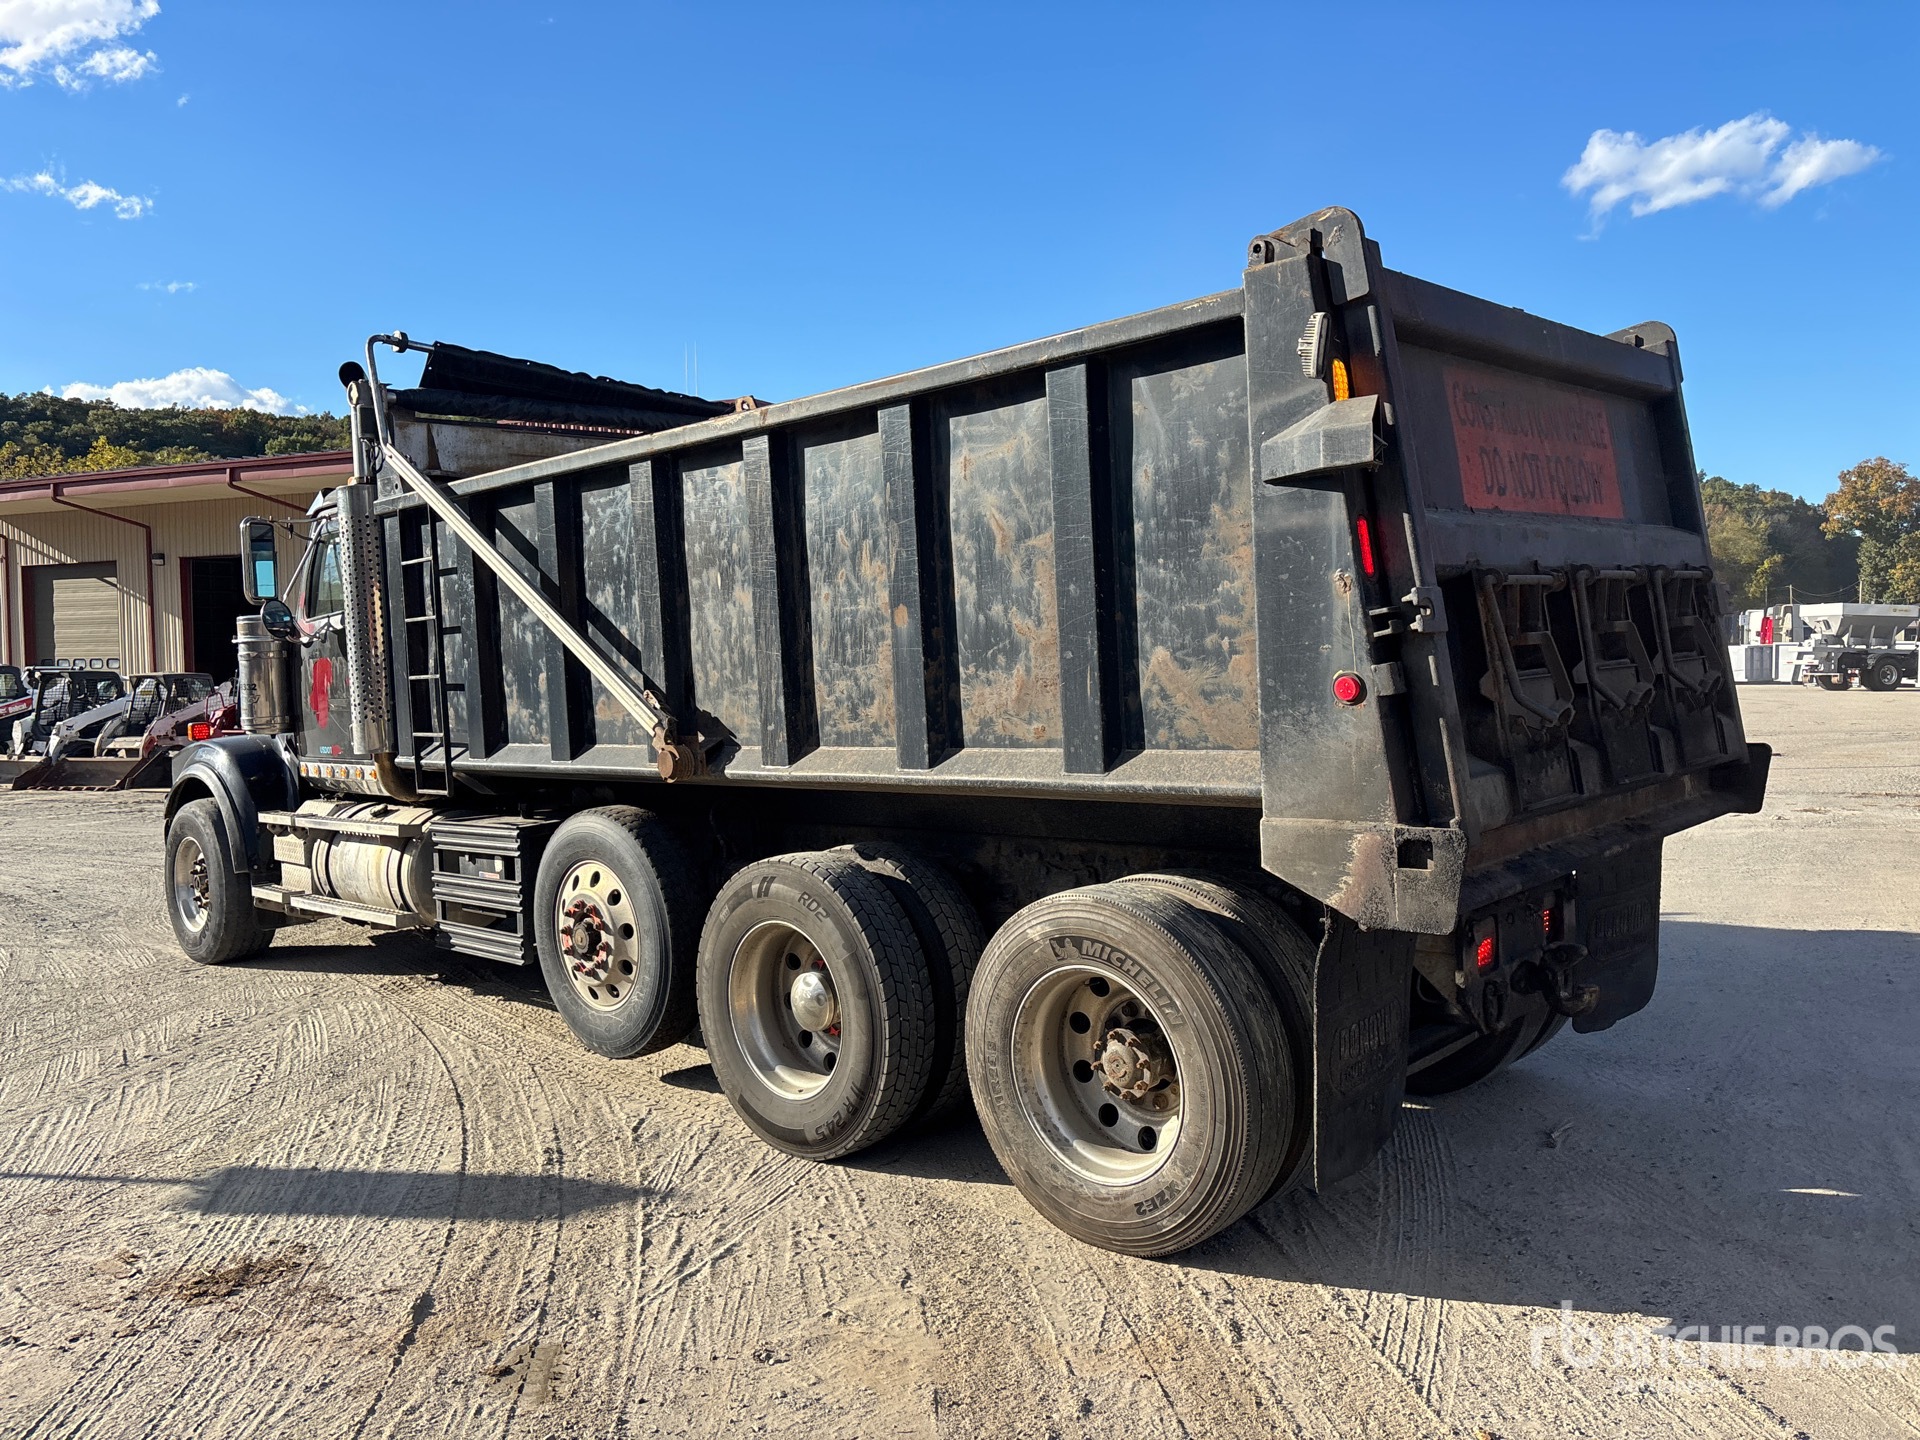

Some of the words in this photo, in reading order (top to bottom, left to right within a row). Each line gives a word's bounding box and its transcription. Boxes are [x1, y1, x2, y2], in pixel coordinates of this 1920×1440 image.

[1480, 446, 1508, 496] DO
[1507, 450, 1544, 499] NOT
[1547, 455, 1605, 504] FOLLOW
[798, 891, 831, 923] RD2
[1081, 939, 1185, 1029] MICHELIN
[1134, 1179, 1181, 1216] XZE2
